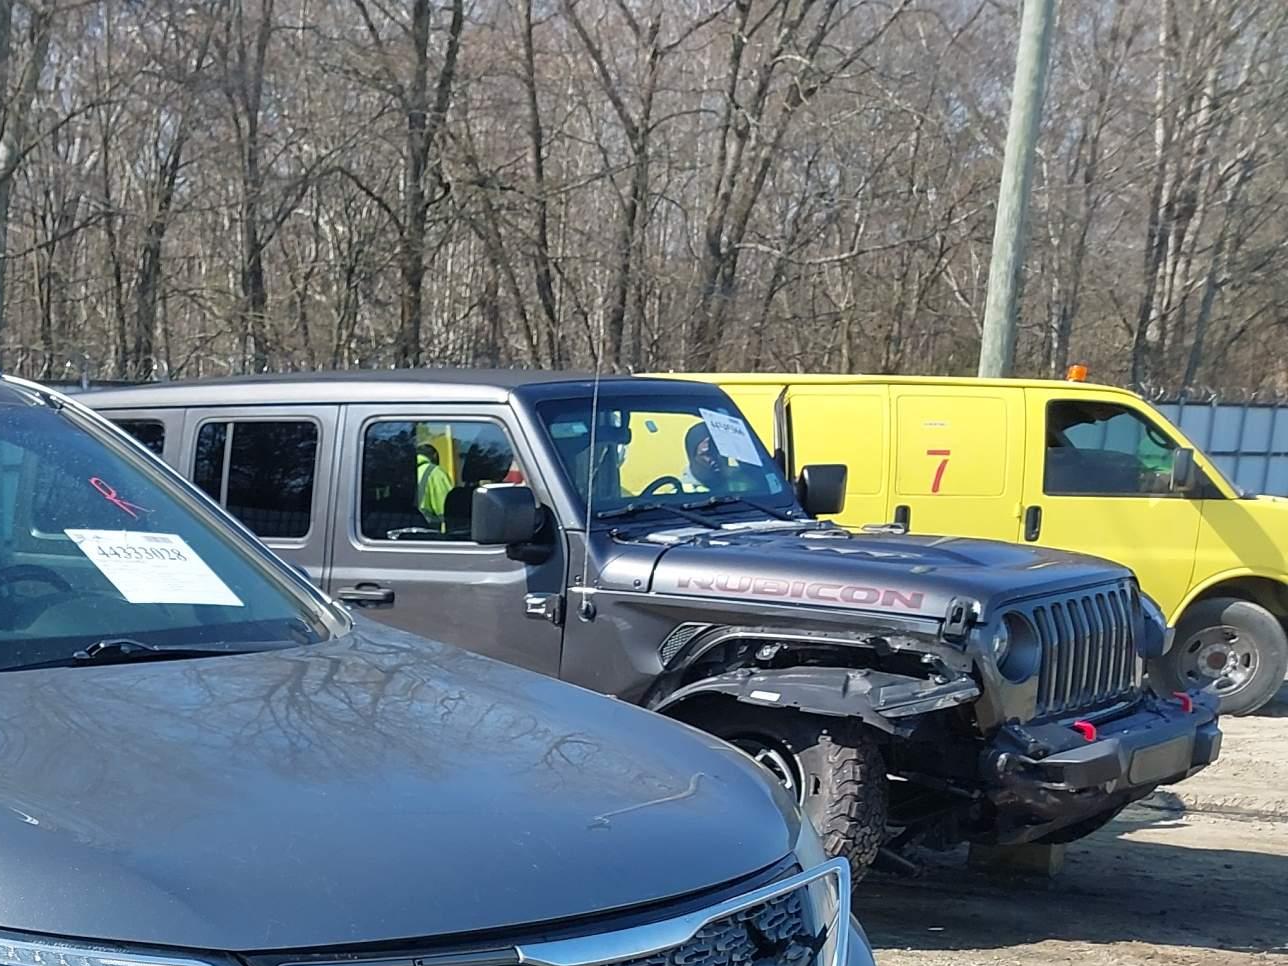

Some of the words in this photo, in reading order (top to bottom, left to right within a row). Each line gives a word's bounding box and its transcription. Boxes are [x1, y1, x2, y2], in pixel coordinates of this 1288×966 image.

[926, 449, 951, 493] 7
[96, 545, 188, 561] 44333028
[677, 574, 925, 609] RUBICON
